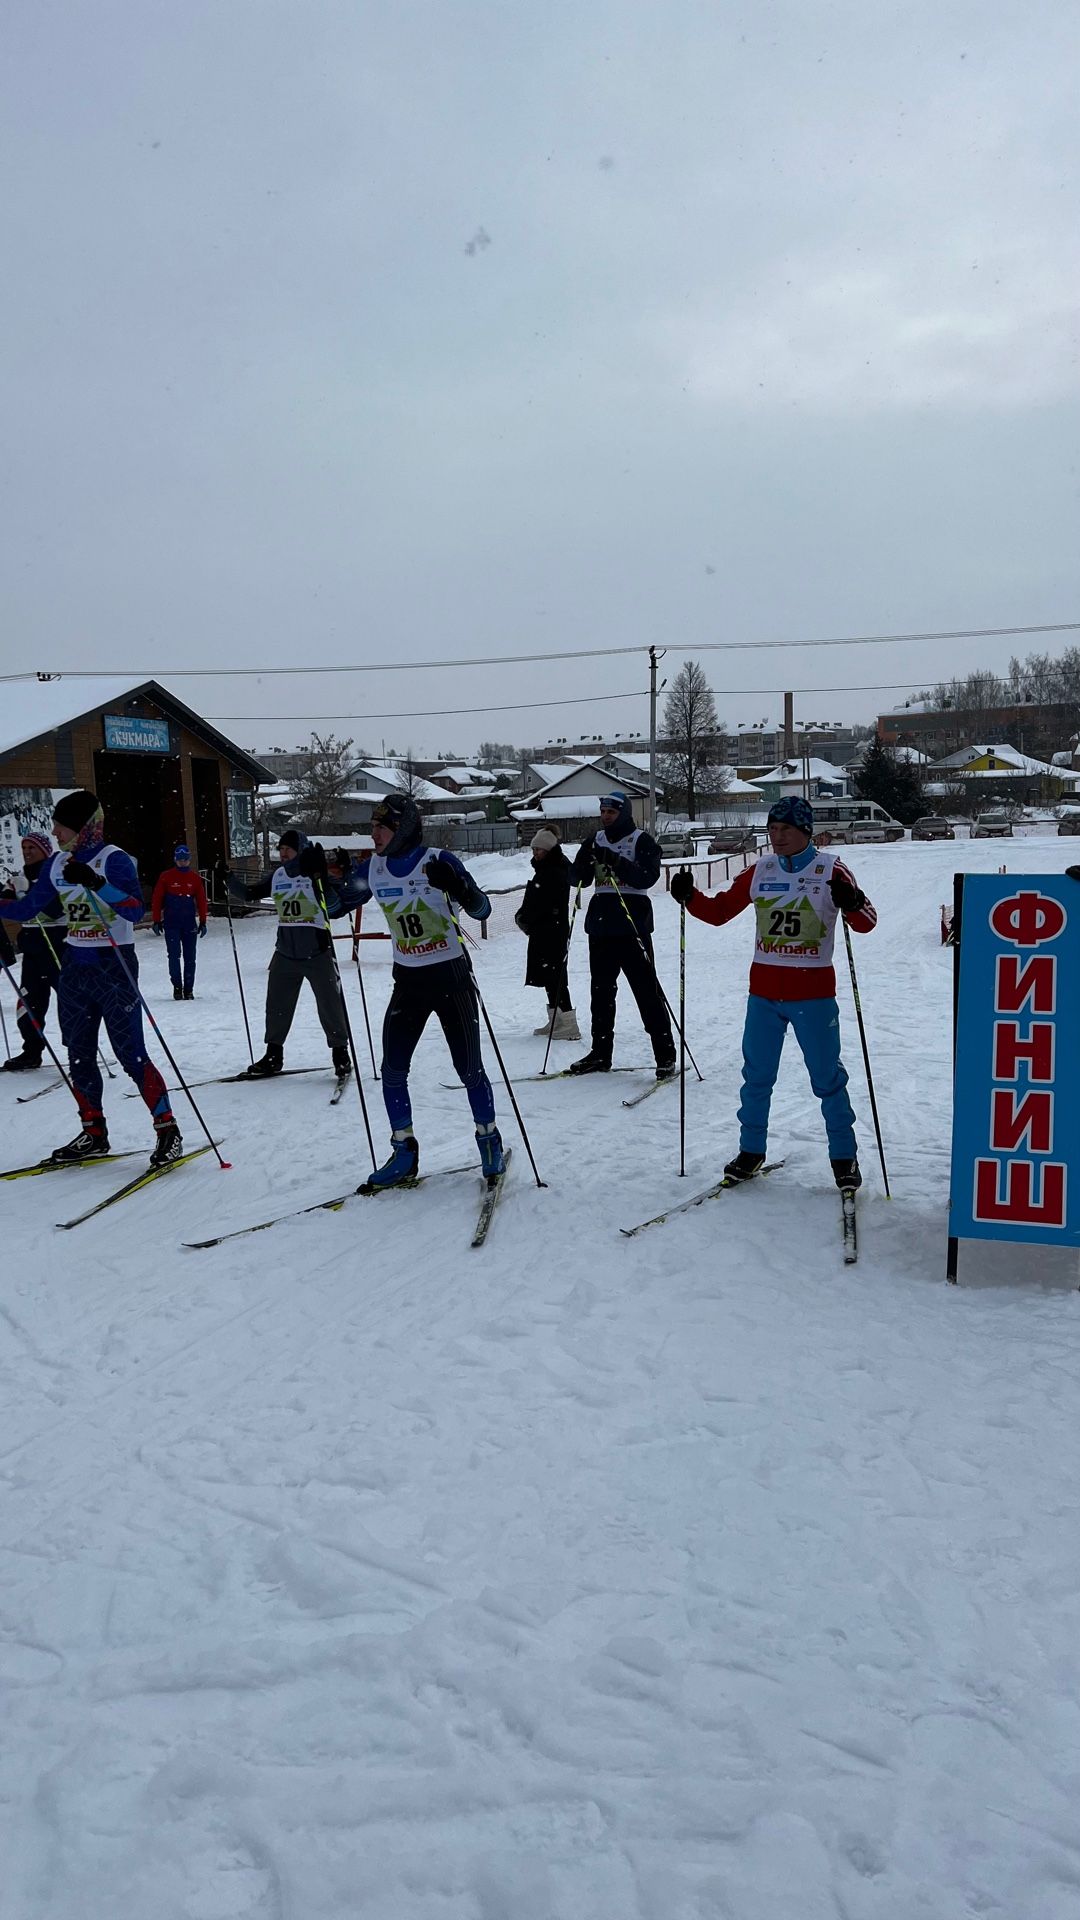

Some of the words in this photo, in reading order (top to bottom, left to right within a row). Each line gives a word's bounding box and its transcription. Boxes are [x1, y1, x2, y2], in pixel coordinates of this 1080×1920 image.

[68, 903, 91, 922] 22
[282, 900, 302, 917] 20
[396, 913, 424, 938] 18
[768, 910, 801, 937] 25
[756, 938, 819, 956] Kukmara
[973, 889, 1068, 1229] ФИНИШ
